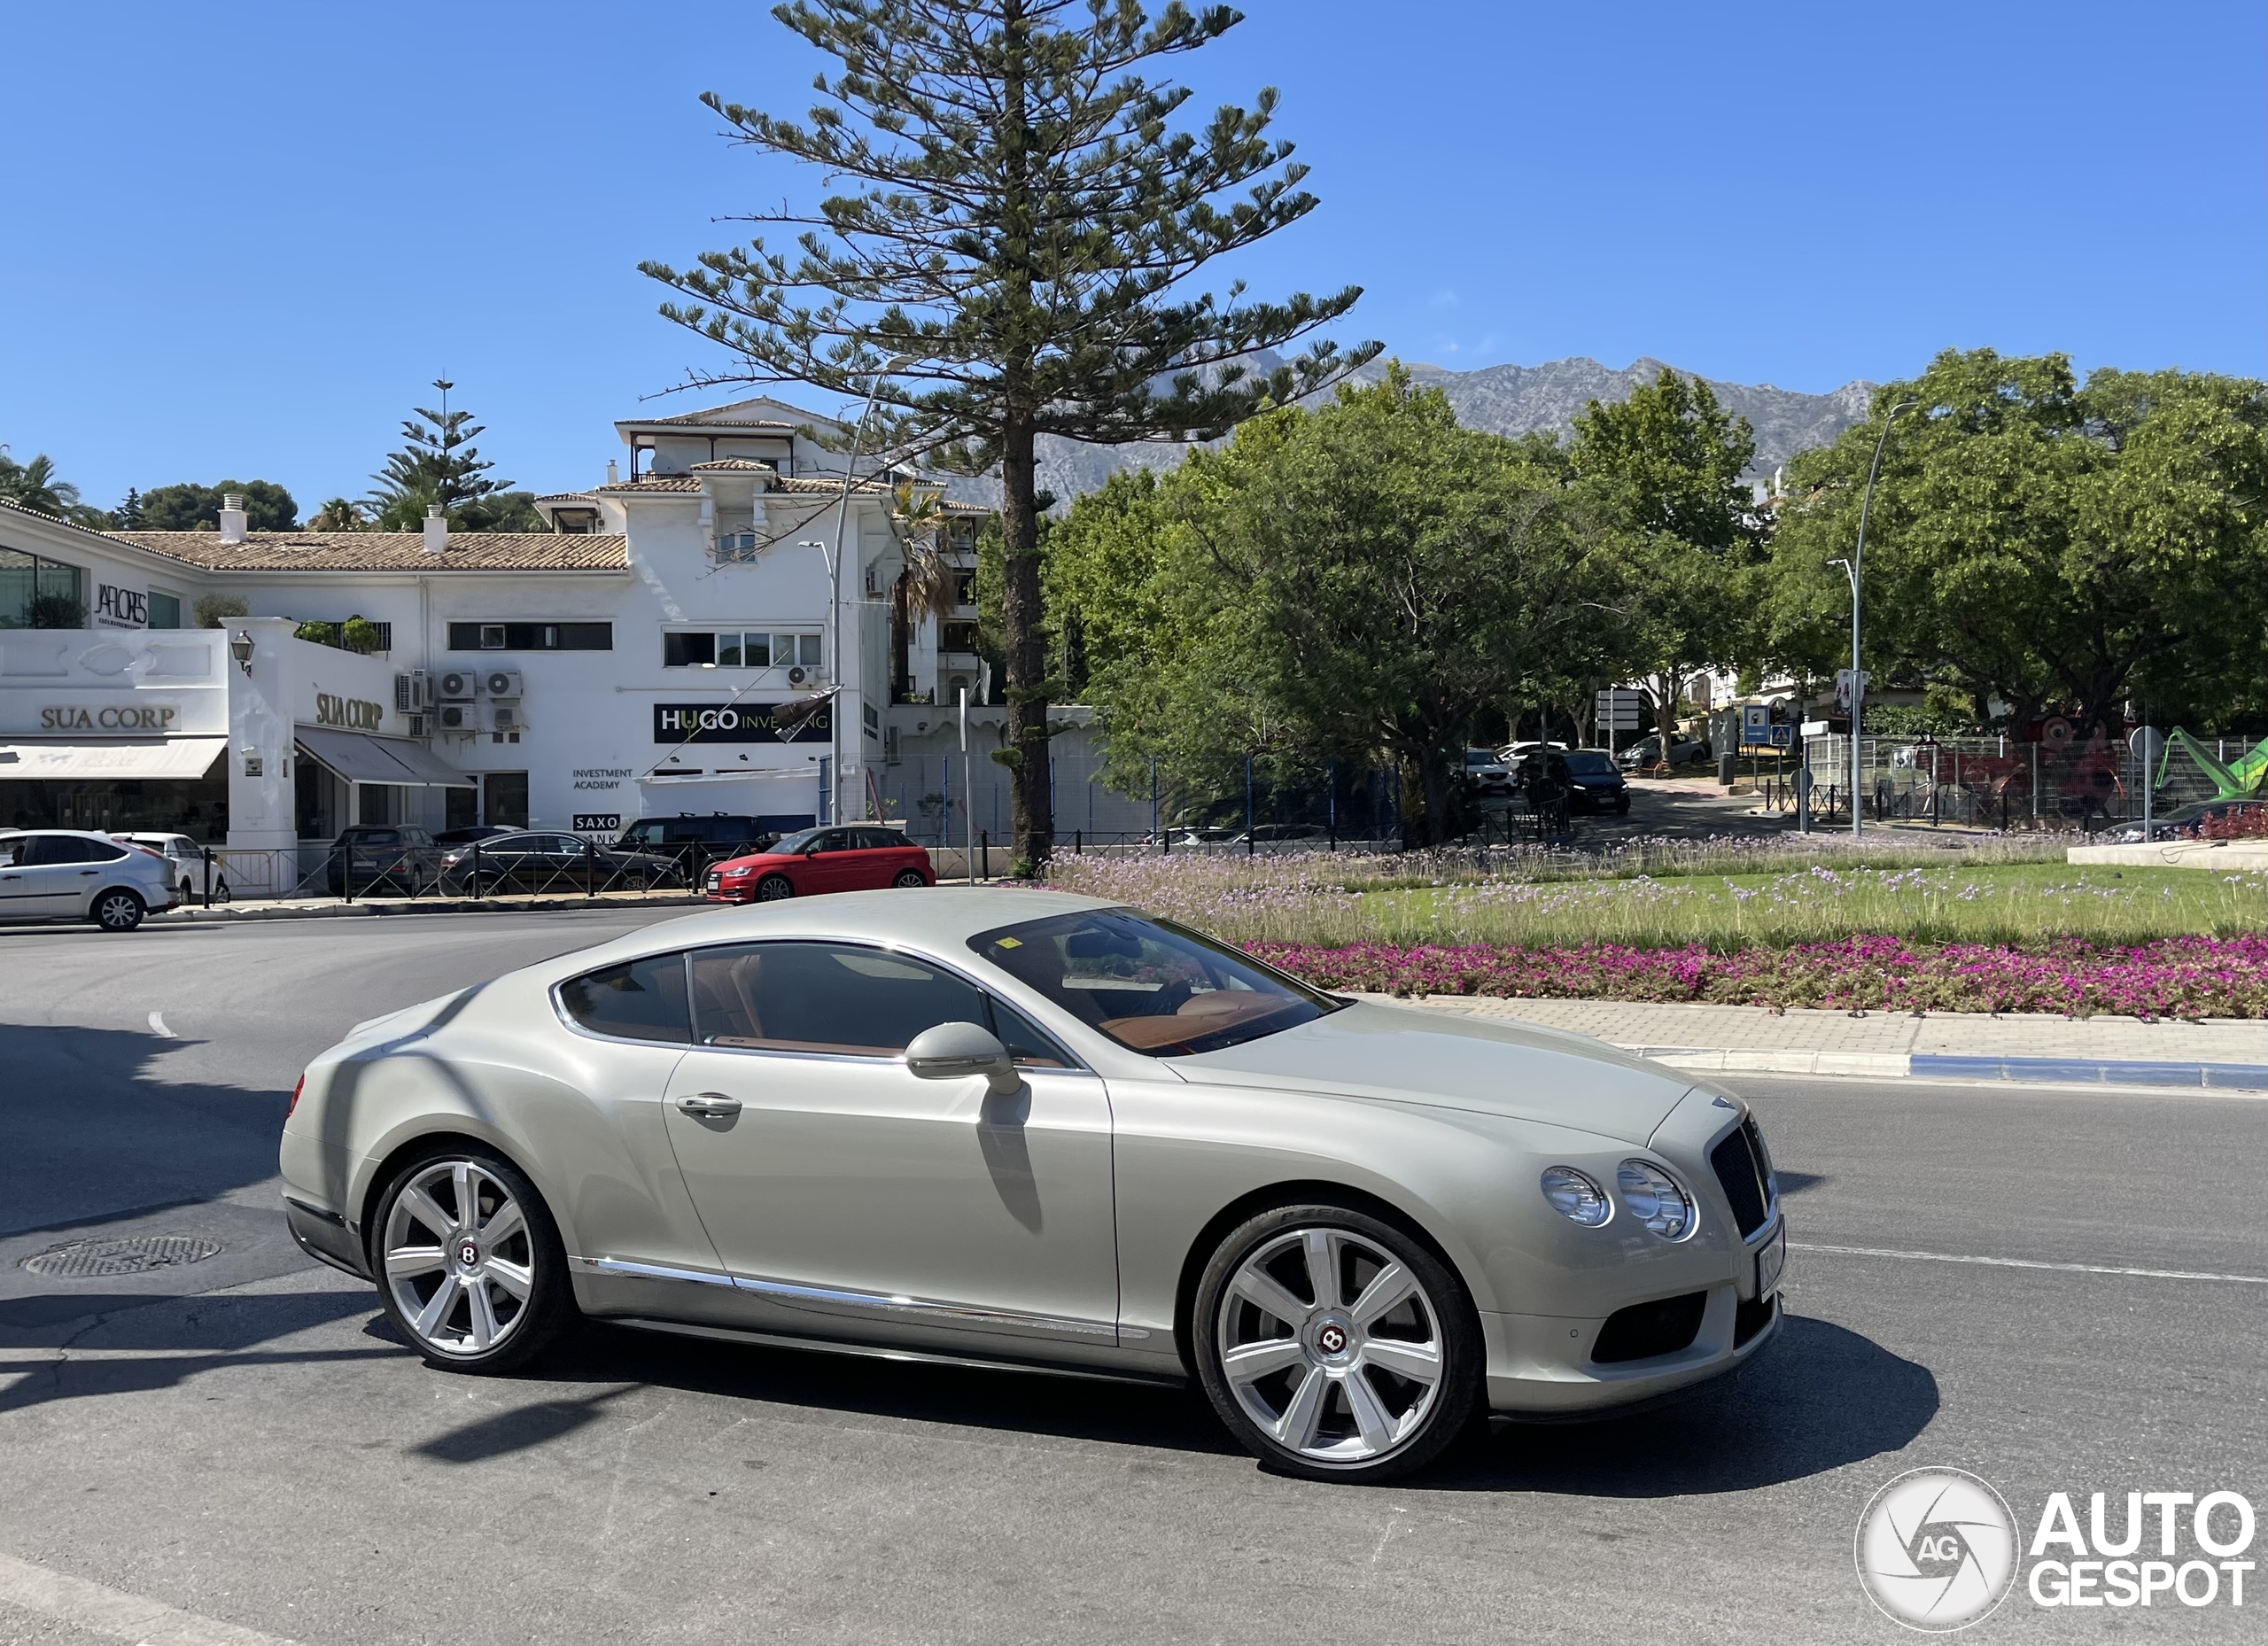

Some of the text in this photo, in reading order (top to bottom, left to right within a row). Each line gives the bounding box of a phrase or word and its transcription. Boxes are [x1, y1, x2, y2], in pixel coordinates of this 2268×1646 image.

[41, 709, 175, 729] SUA CORP
[317, 693, 383, 731] SUA CORP
[662, 709, 828, 737] HUGO INVENG
[573, 769, 633, 778] INVESTMENT
[574, 780, 620, 790] ACADEMY
[576, 817, 617, 829] SAXO
